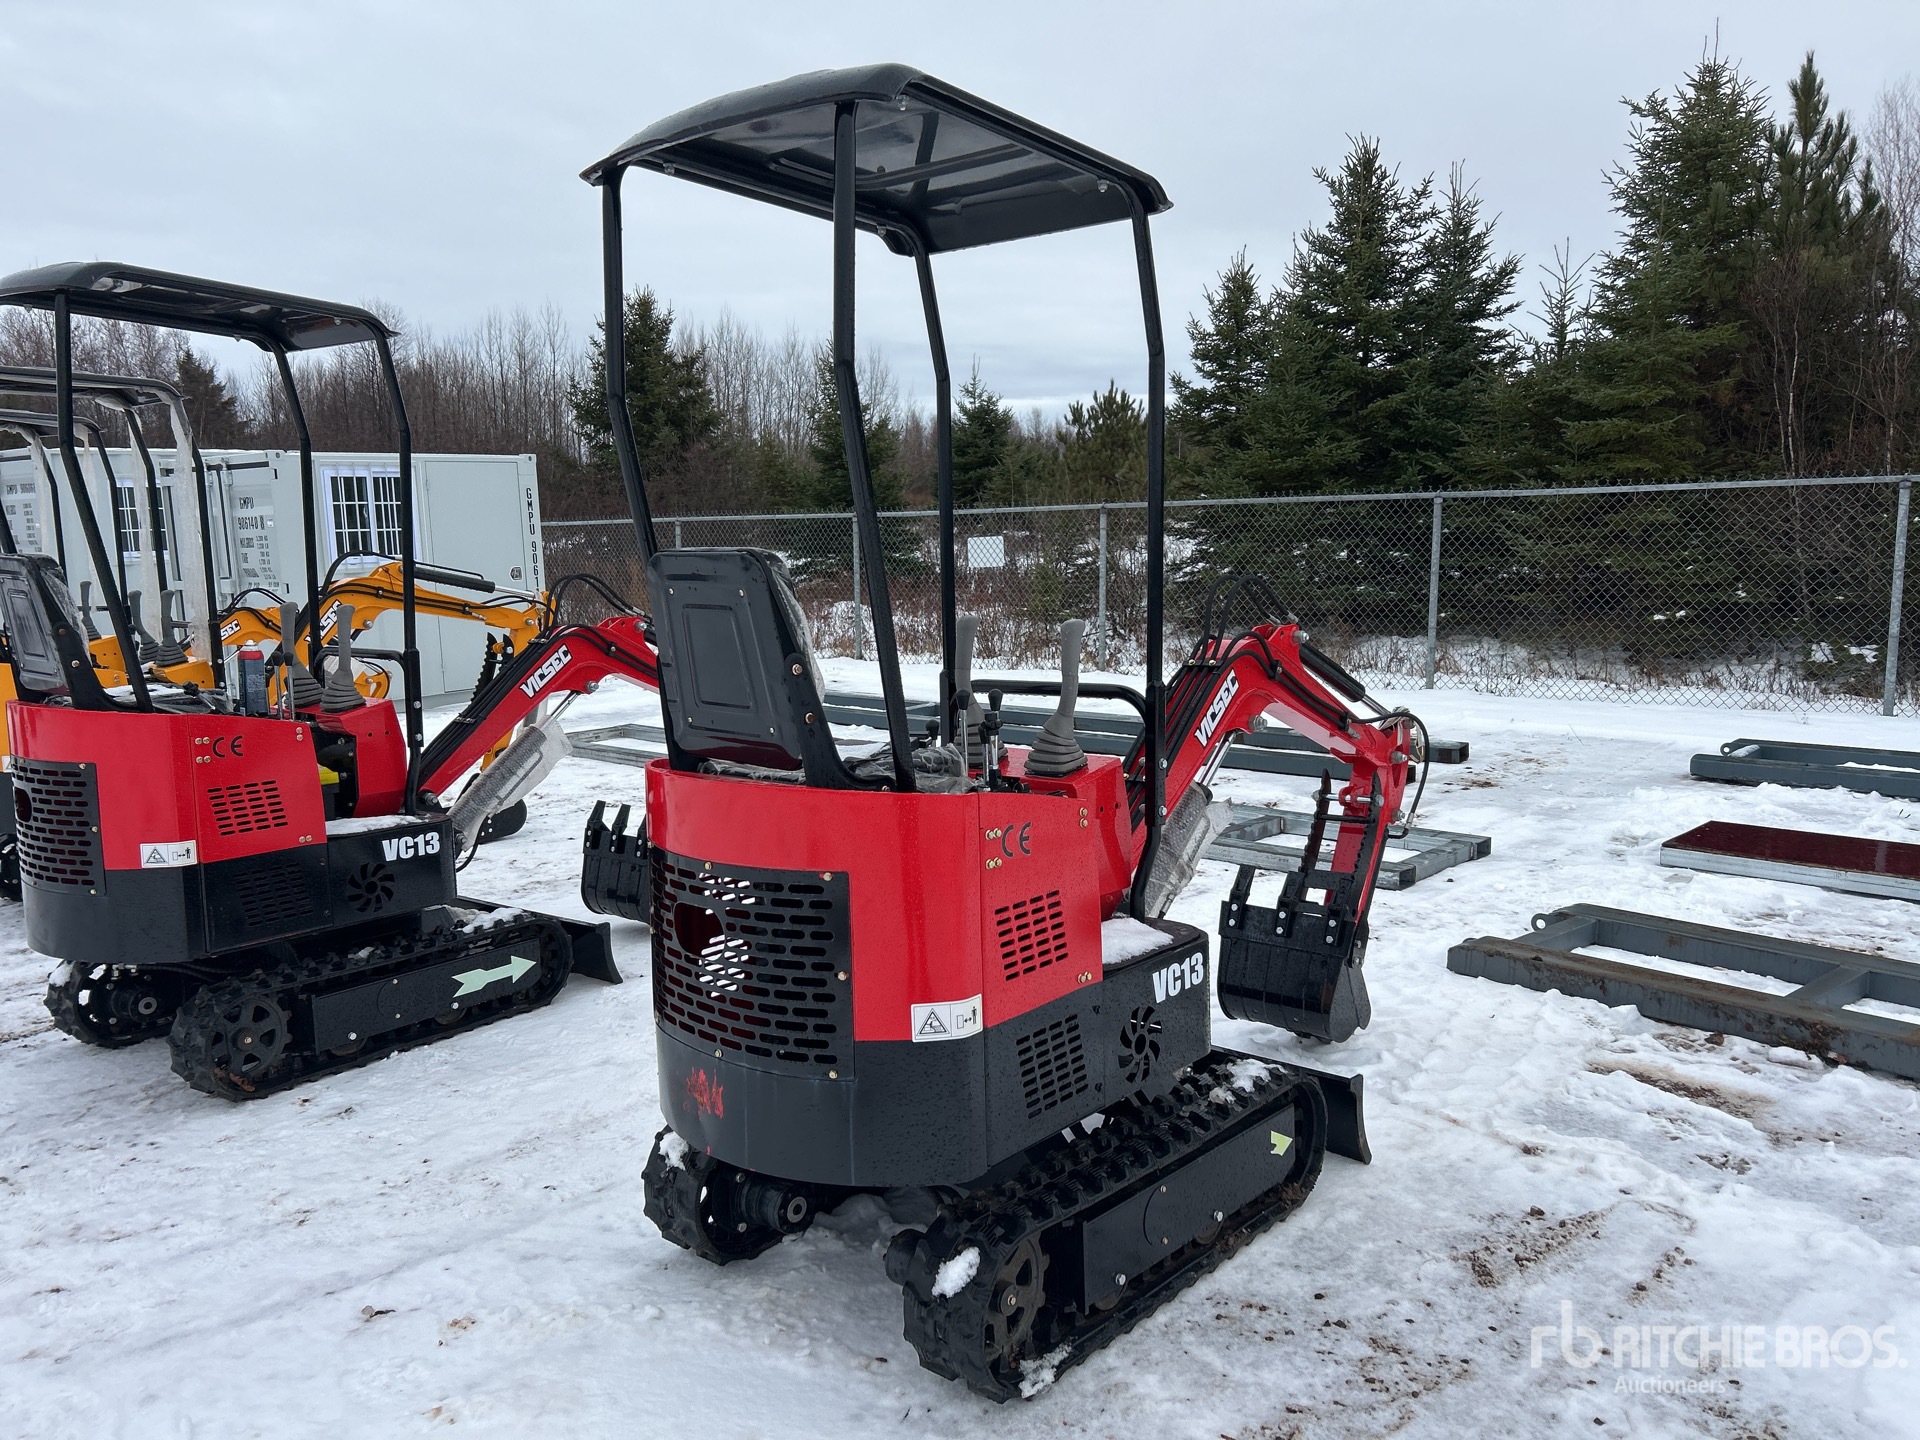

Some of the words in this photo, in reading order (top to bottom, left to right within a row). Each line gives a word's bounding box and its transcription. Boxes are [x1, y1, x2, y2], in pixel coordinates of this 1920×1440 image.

[238, 516, 258, 530] 906140
[526, 488, 536, 535] GMPU
[531, 541, 541, 592] 9061
[519, 643, 573, 698] VICSEC
[1194, 669, 1240, 747] VICSEC
[212, 735, 244, 758] CE
[382, 831, 441, 862] VC13
[1001, 821, 1032, 858] CE
[1152, 952, 1204, 1004] VC13
